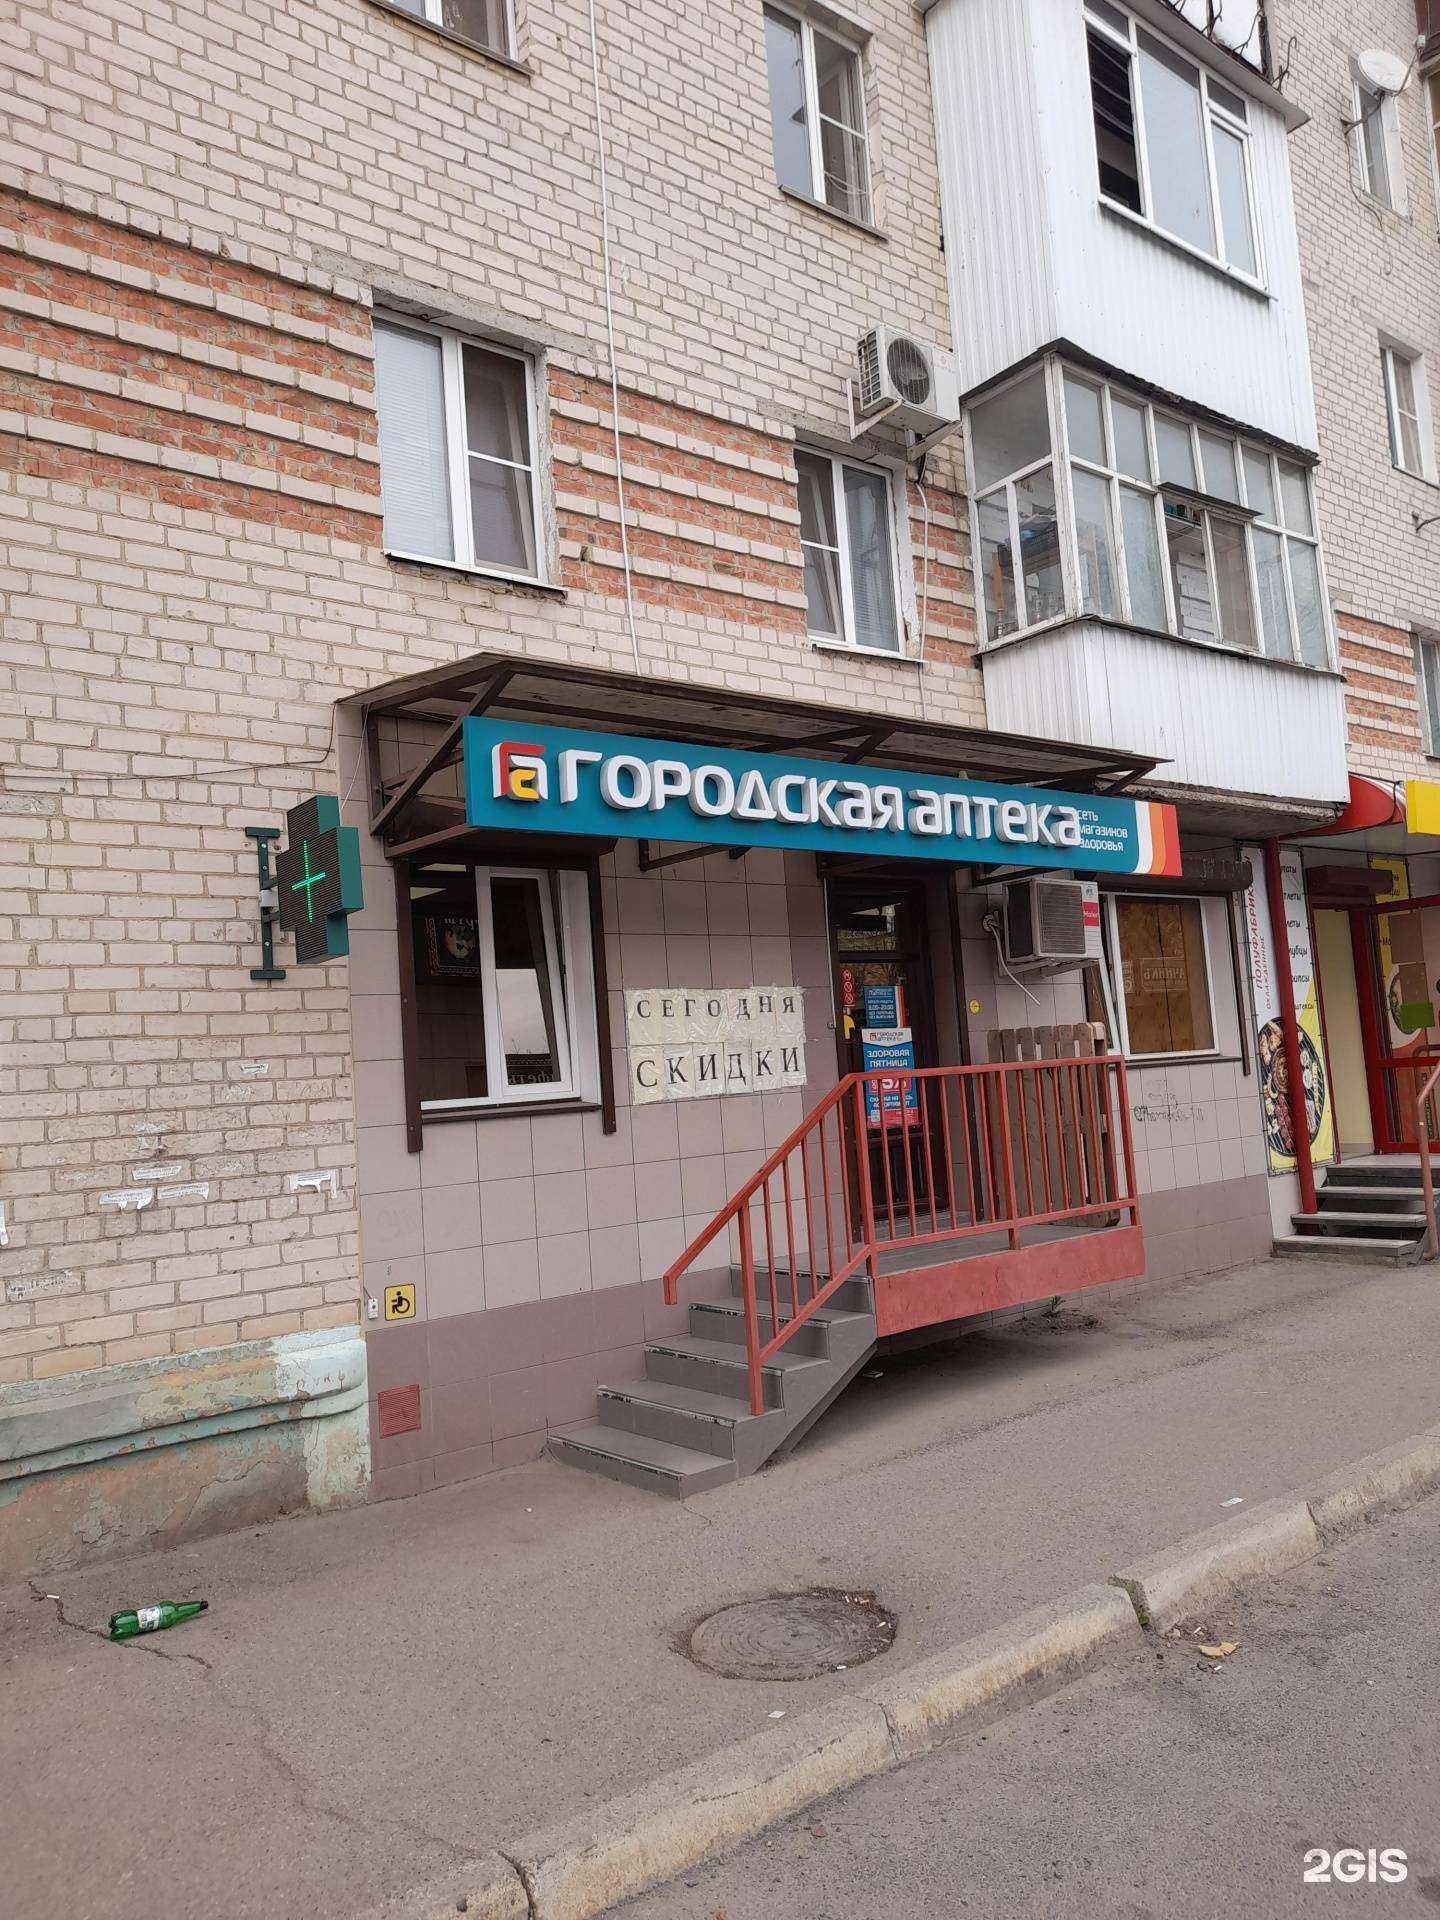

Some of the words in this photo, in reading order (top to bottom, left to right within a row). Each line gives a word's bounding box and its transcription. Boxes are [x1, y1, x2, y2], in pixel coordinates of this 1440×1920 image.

[1080, 838, 1124, 852] здоровья
[636, 995, 796, 1020] СЕГОДНЯ
[867, 1049, 910, 1058] ЗДОРОВАЯ
[636, 1047, 800, 1088] СКИДКИ
[870, 1059, 908, 1068] ПЯТНИЦА
